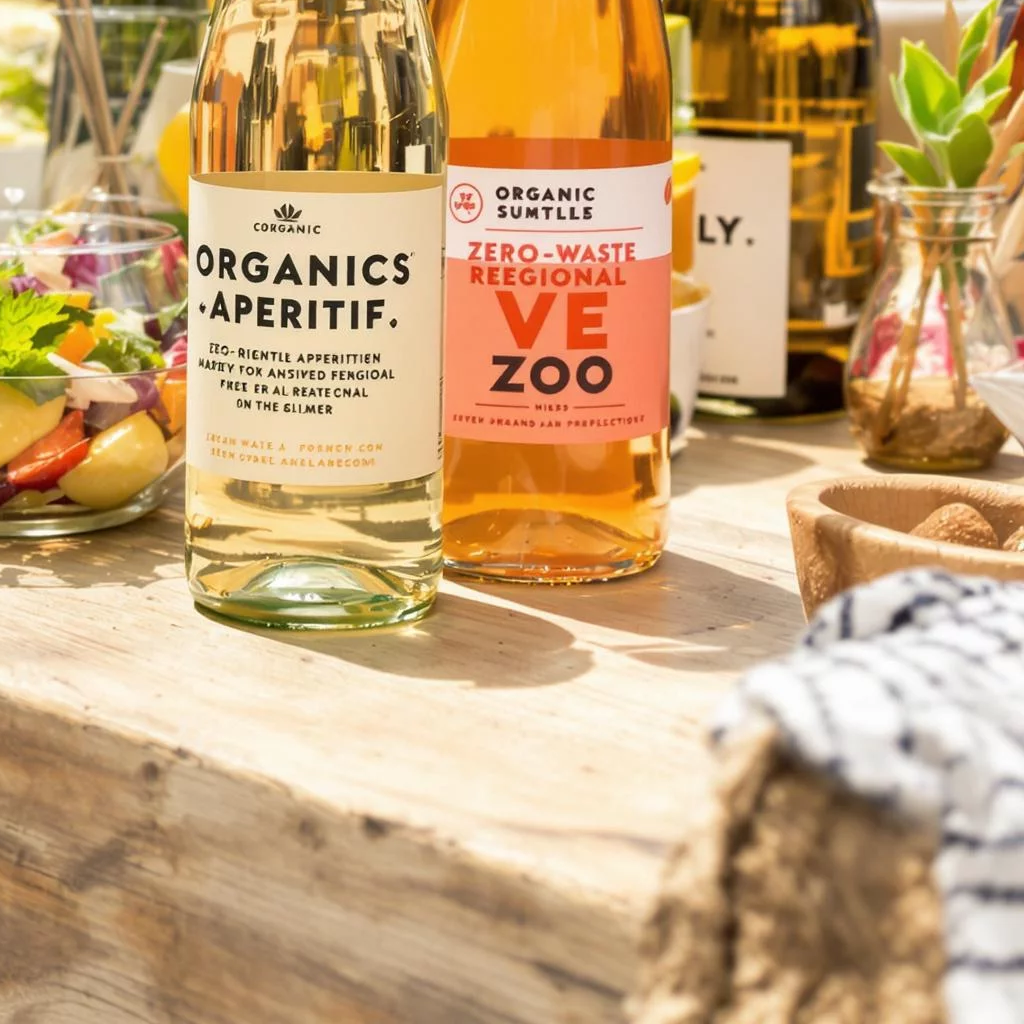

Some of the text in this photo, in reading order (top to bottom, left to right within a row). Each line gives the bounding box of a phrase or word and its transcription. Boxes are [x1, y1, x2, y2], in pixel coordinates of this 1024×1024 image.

[495, 186, 596, 202] ORGANIC
[253, 222, 321, 235] CORGANIC
[467, 241, 637, 264] ZERO-WASTE
[470, 266, 627, 287] REEGIONAL
[494, 290, 608, 351] VE
[489, 355, 613, 395] ZOO
[256, 400, 279, 412] THE
